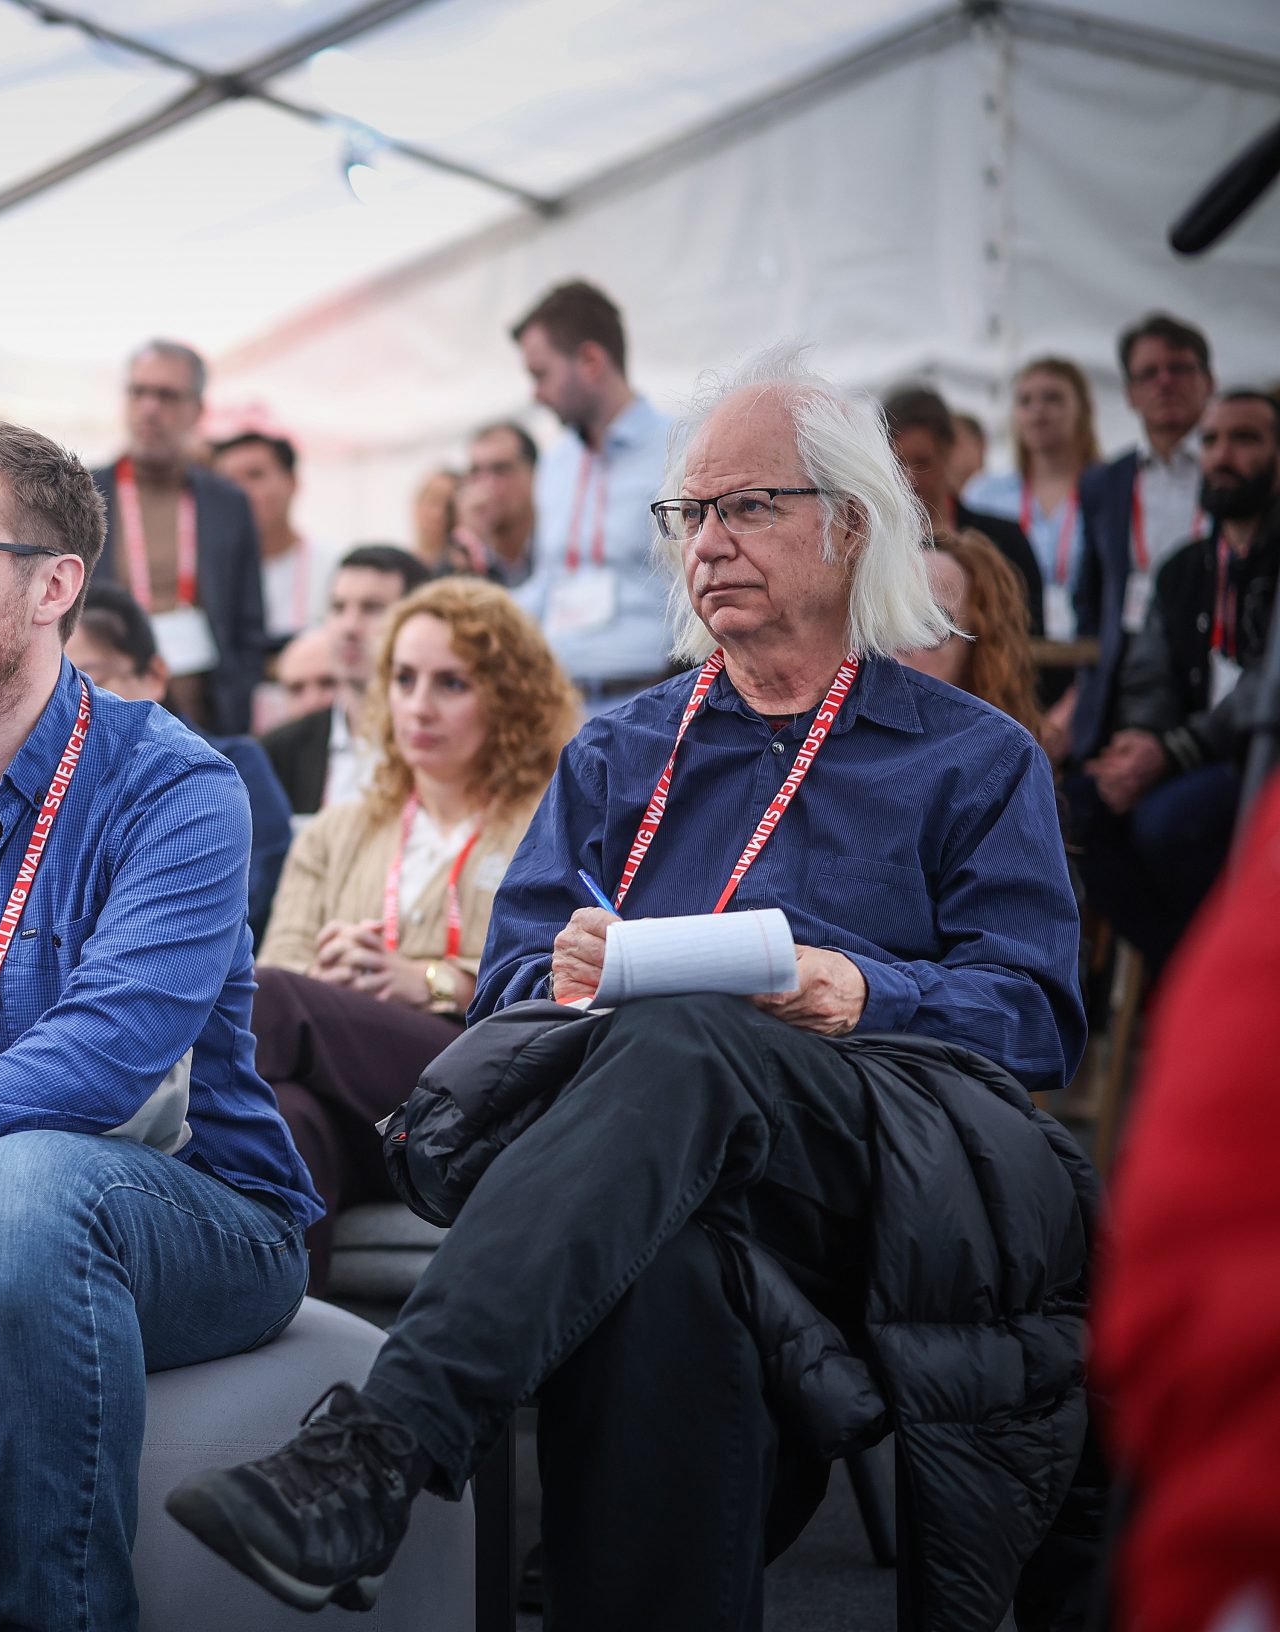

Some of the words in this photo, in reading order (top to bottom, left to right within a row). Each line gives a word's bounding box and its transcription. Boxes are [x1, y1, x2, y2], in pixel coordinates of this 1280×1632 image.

[689, 653, 725, 706] WALLS
[816, 666, 857, 723] WALLS
[16, 813, 54, 883] WALLS
[44, 723, 88, 810] SCIENCE
[772, 724, 827, 808] SCIENCE
[730, 808, 782, 883] SUMMIT
